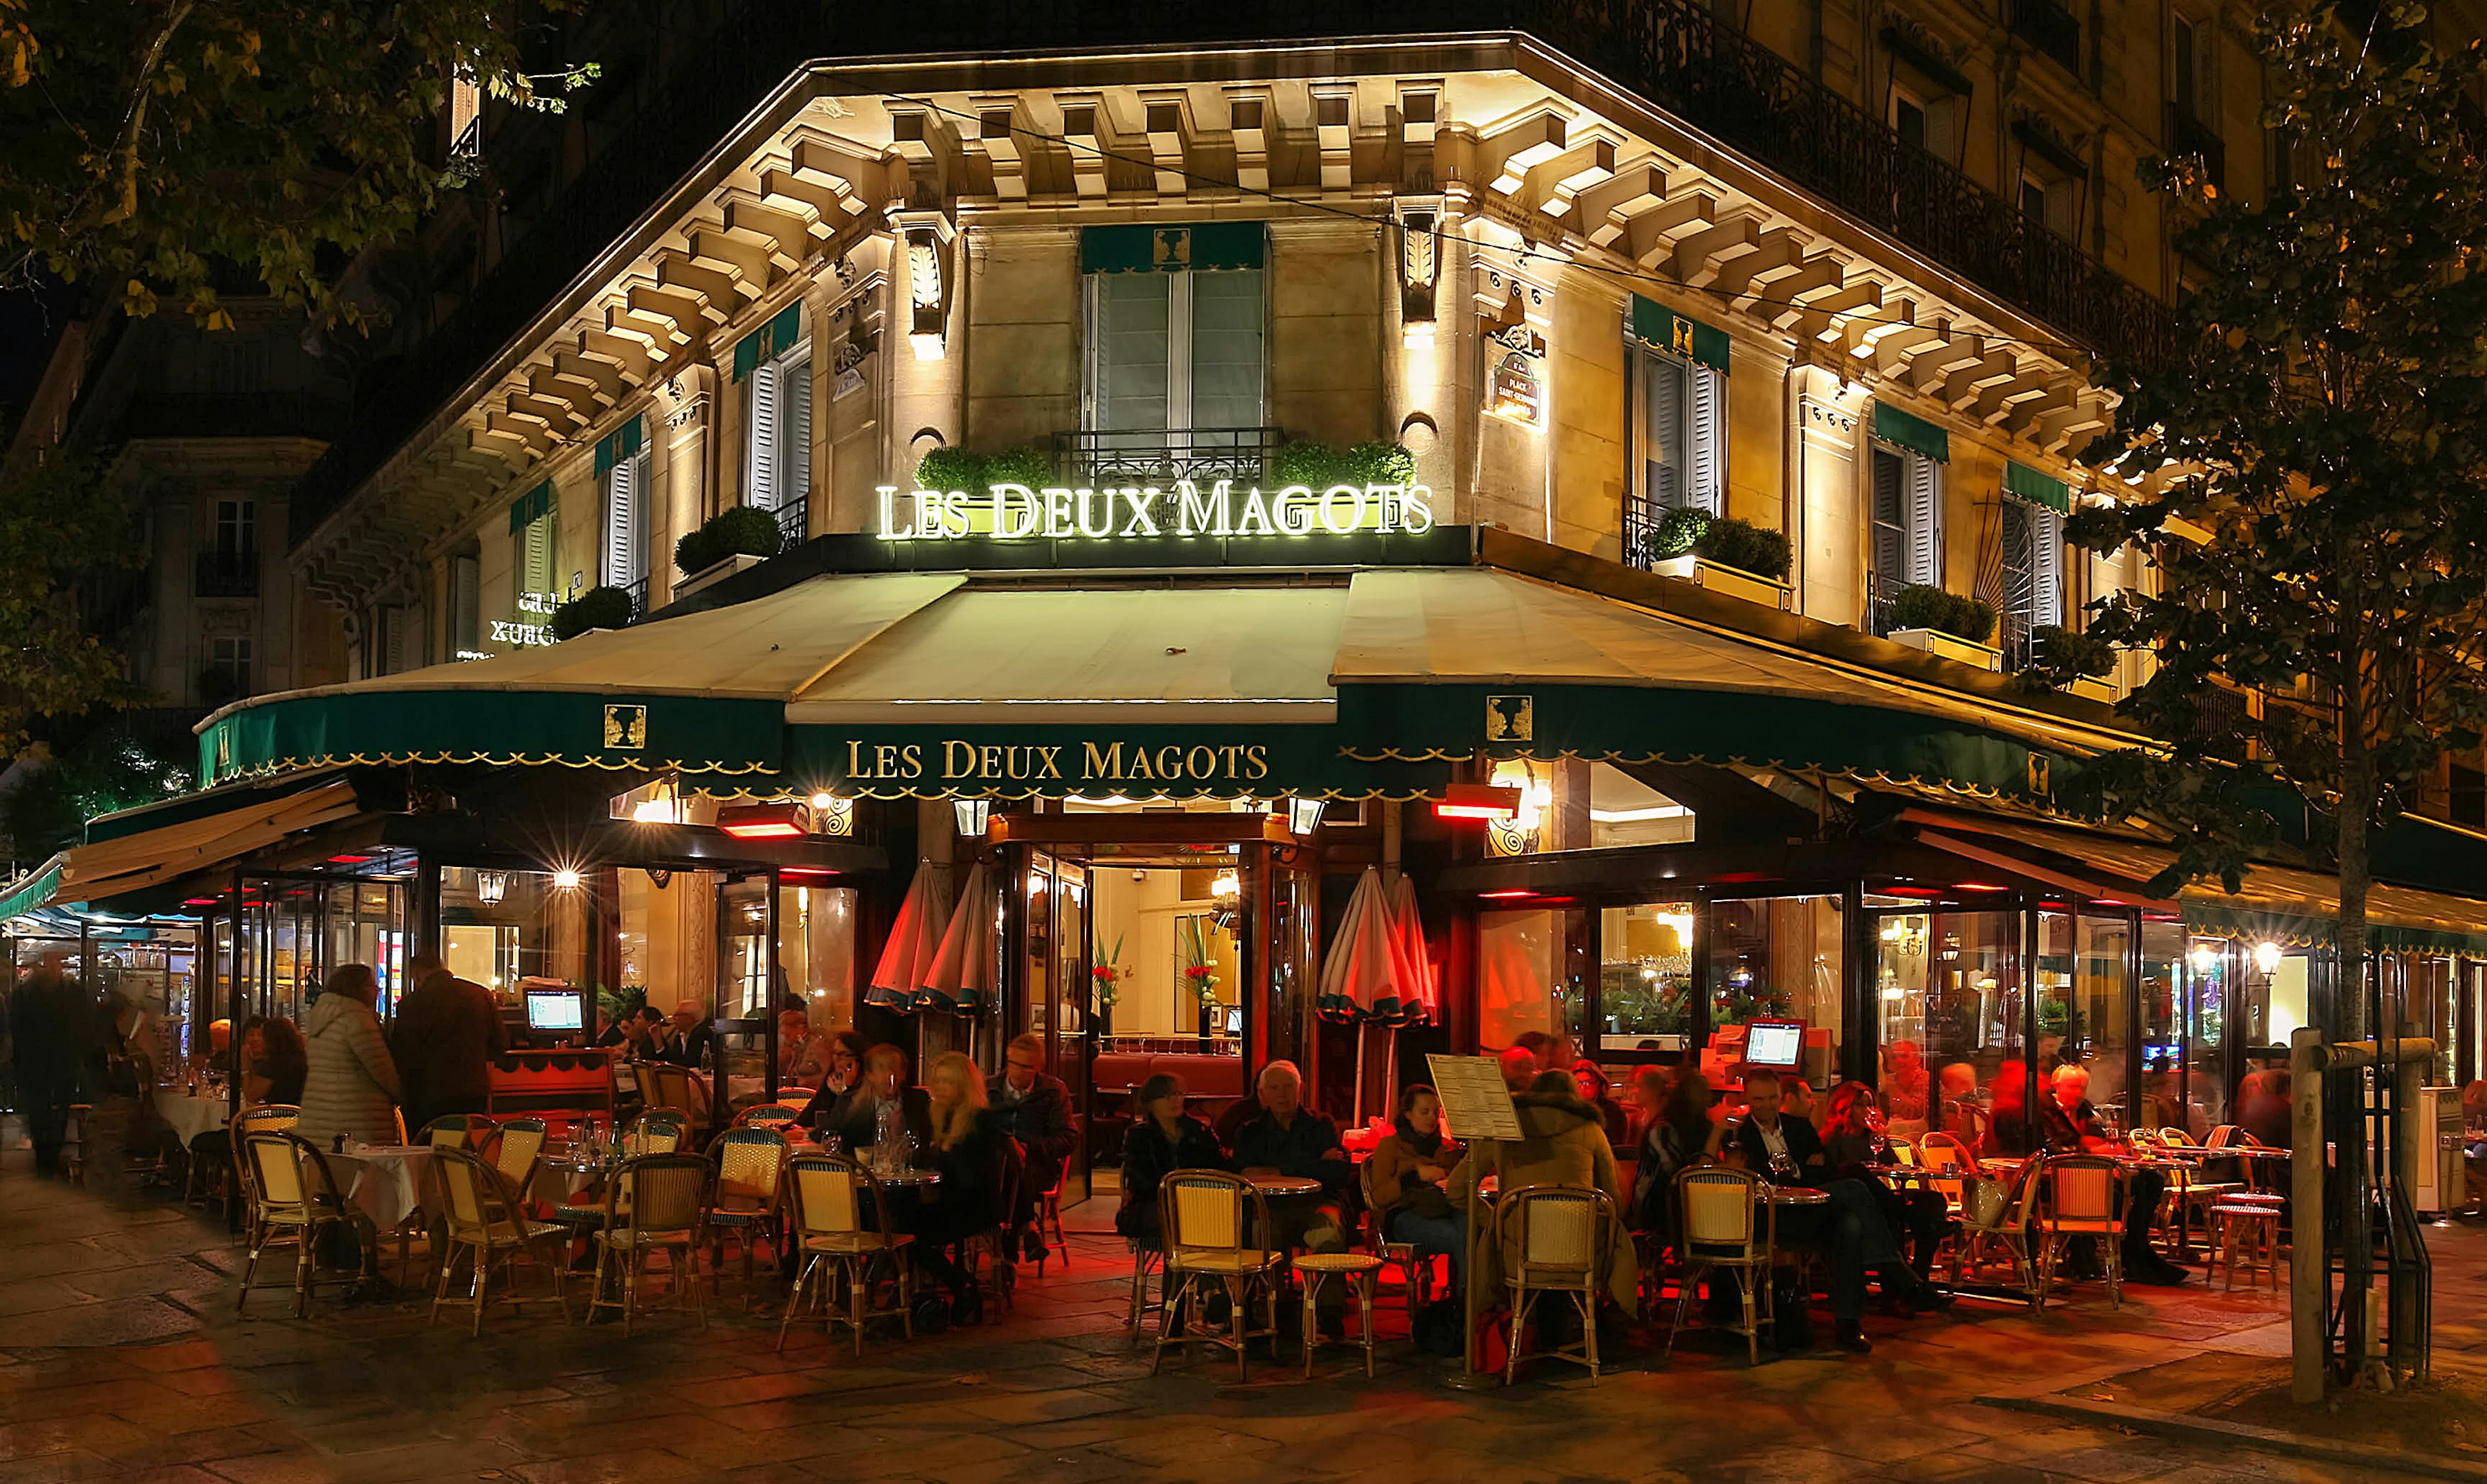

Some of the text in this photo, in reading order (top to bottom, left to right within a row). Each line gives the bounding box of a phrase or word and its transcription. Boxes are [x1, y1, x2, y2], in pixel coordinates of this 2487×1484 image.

[1509, 378, 1527, 392] PLACE
[875, 479, 1433, 541] LES DEUX MAGOTS
[846, 741, 1269, 781] LES DEUX MAGOTS
